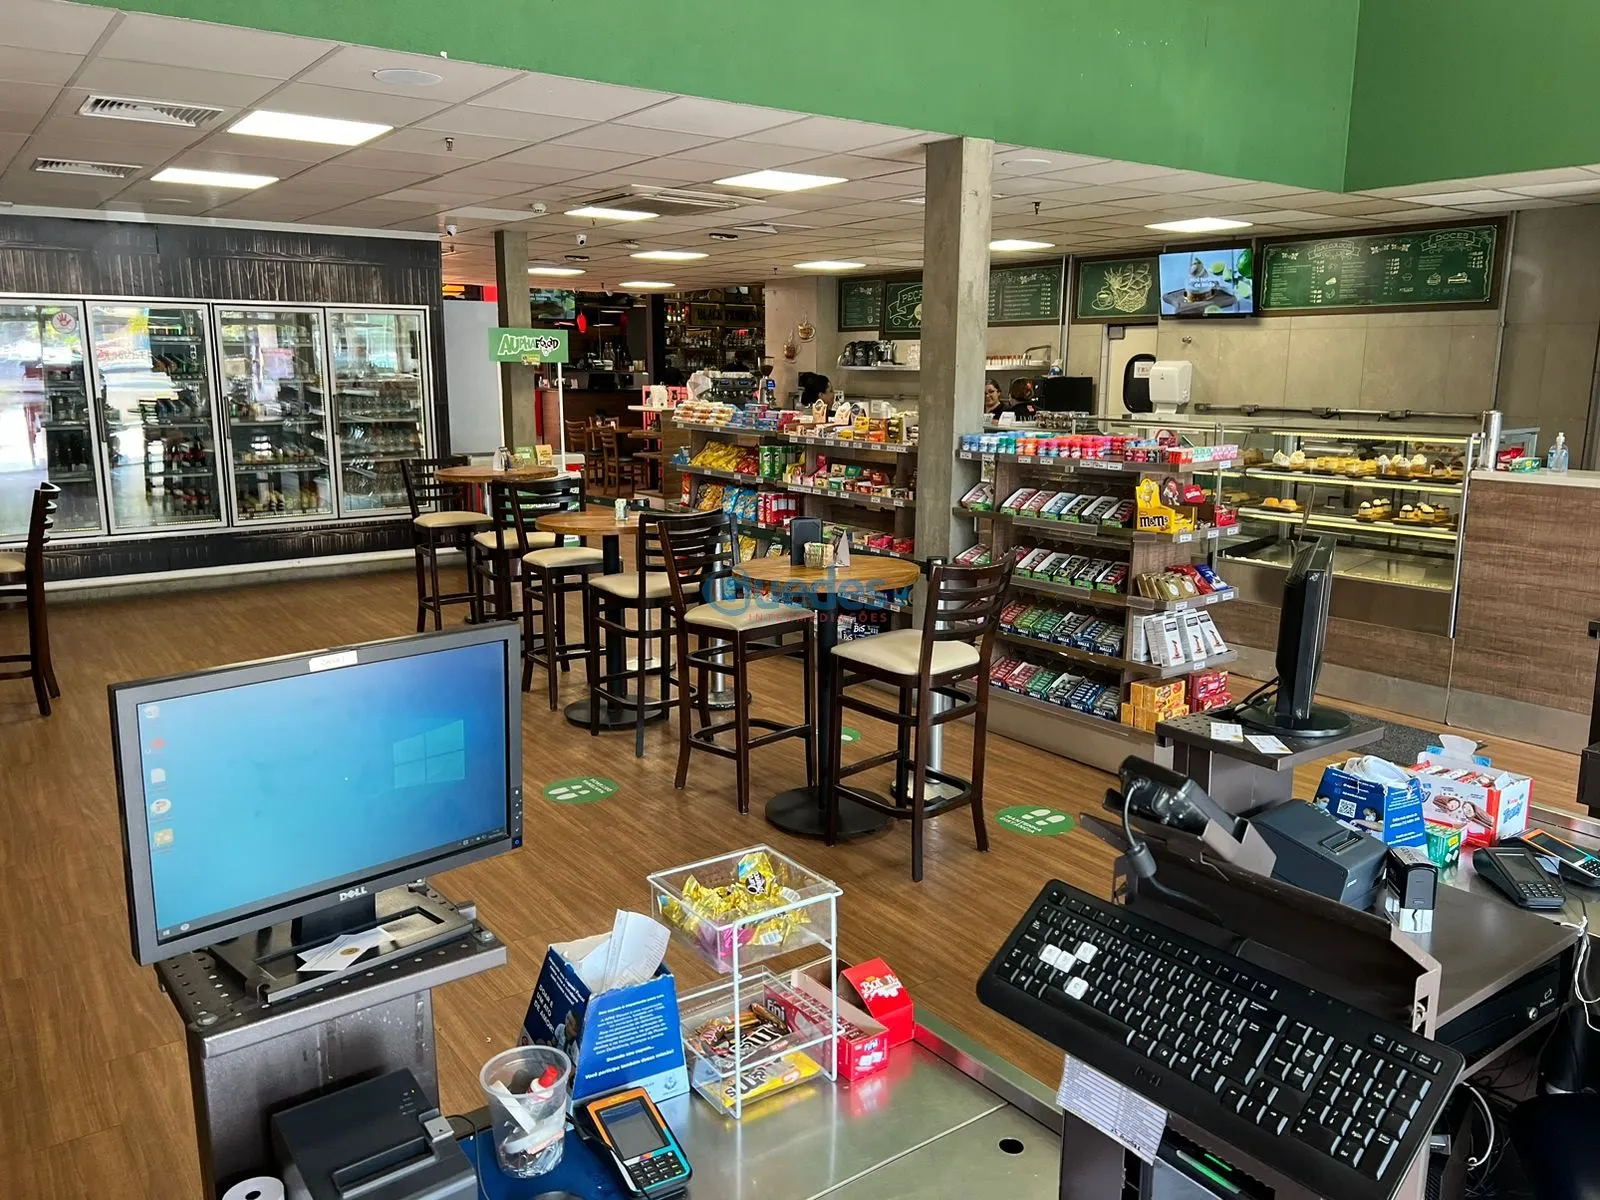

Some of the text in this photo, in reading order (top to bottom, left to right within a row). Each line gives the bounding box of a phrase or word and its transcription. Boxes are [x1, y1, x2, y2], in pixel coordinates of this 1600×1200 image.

[1435, 232, 1470, 241] DOCES
[340, 886, 367, 901] DELL
[767, 999, 785, 1018] Fini
